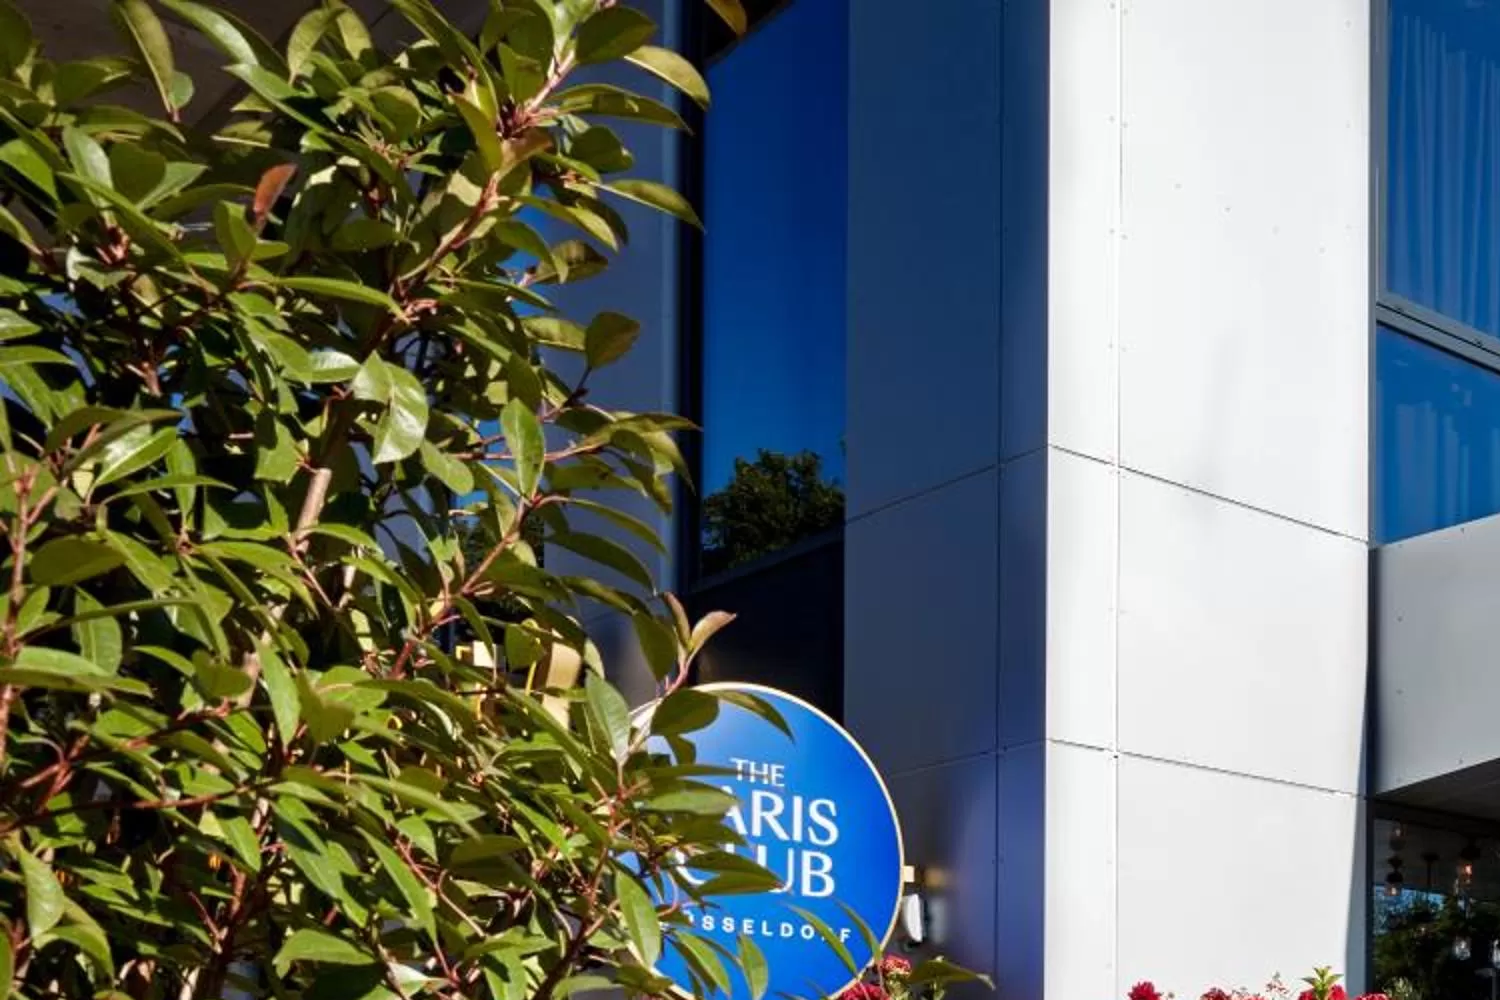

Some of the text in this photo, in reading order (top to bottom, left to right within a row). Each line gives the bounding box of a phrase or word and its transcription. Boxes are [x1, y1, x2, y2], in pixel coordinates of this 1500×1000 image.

[729, 756, 786, 788] THE
[718, 784, 840, 847] ARIS
[674, 842, 836, 898] UB
